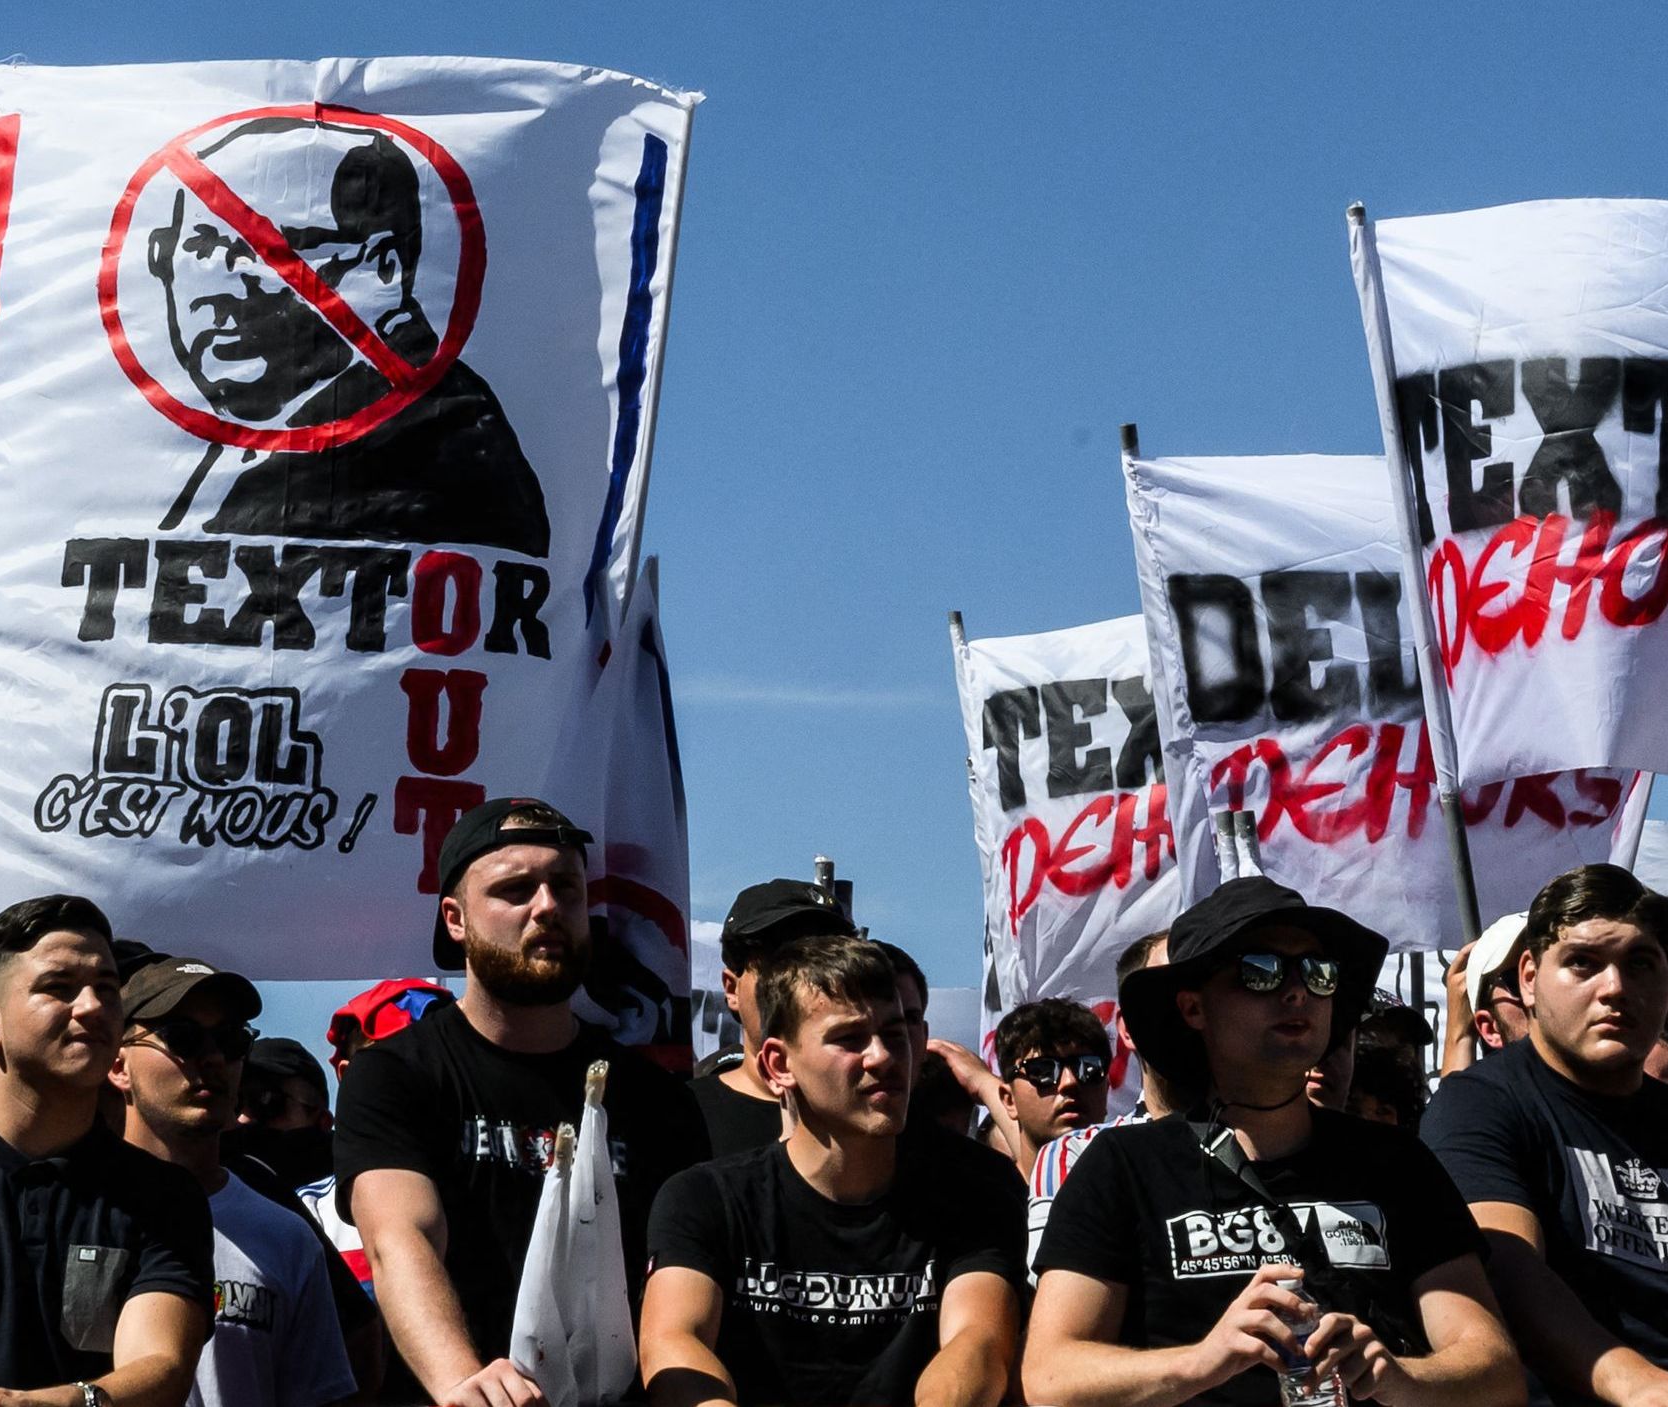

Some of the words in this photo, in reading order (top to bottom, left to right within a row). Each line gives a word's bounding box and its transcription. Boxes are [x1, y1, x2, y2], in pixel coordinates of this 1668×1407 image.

[60, 537, 552, 660] TEXTOR
[983, 675, 1169, 813] TEX
[34, 774, 188, 839] C'EST
[179, 786, 338, 849] NOUS
[1002, 782, 1178, 937] DEH
